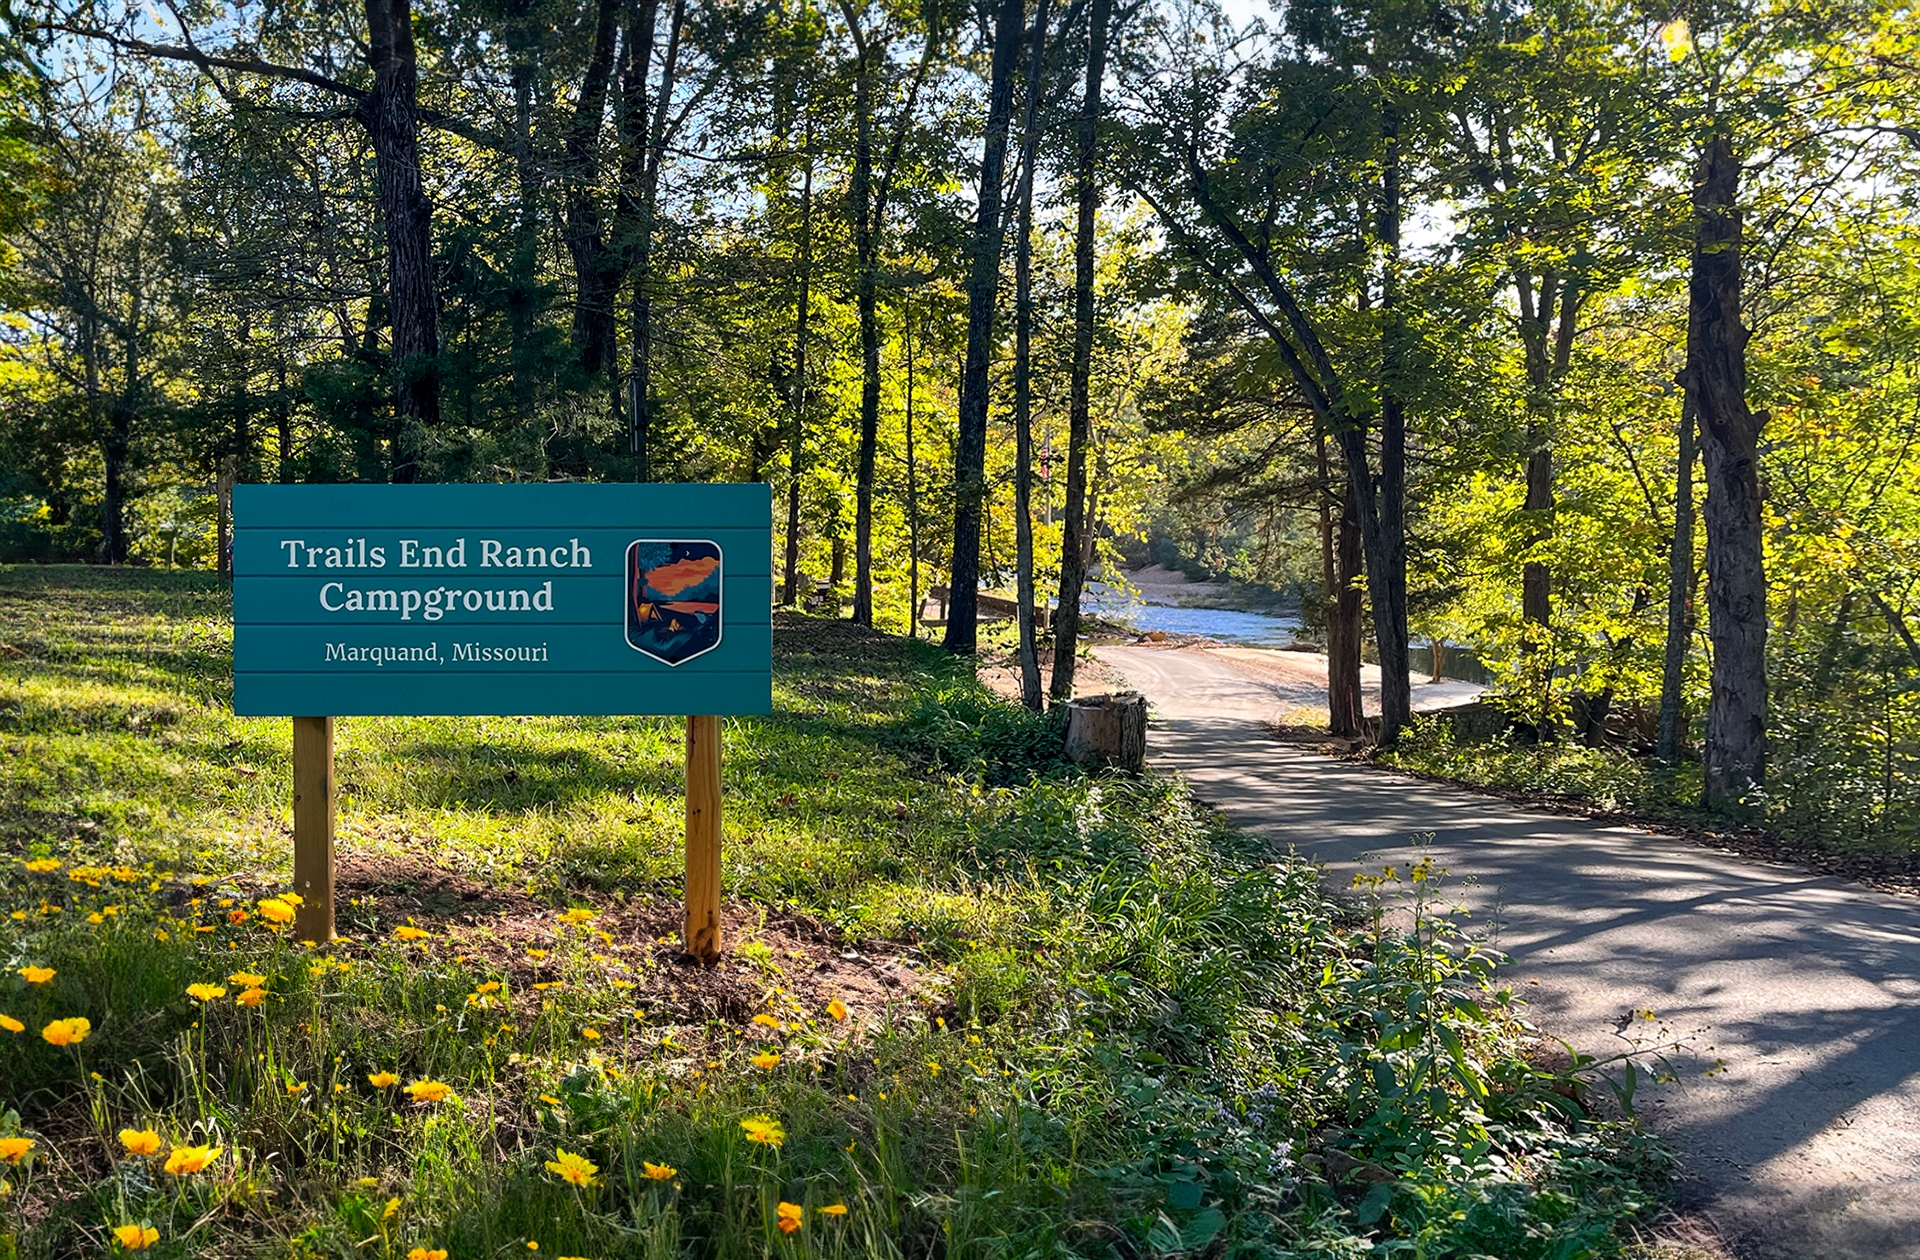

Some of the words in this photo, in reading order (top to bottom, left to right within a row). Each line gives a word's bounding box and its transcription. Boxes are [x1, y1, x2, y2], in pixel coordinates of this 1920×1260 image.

[281, 538, 386, 568] Trails
[399, 538, 467, 568] End
[480, 538, 593, 568] Ranch
[319, 581, 554, 620] Campground
[325, 642, 445, 666] Marquand,
[452, 642, 549, 662] Missouri
